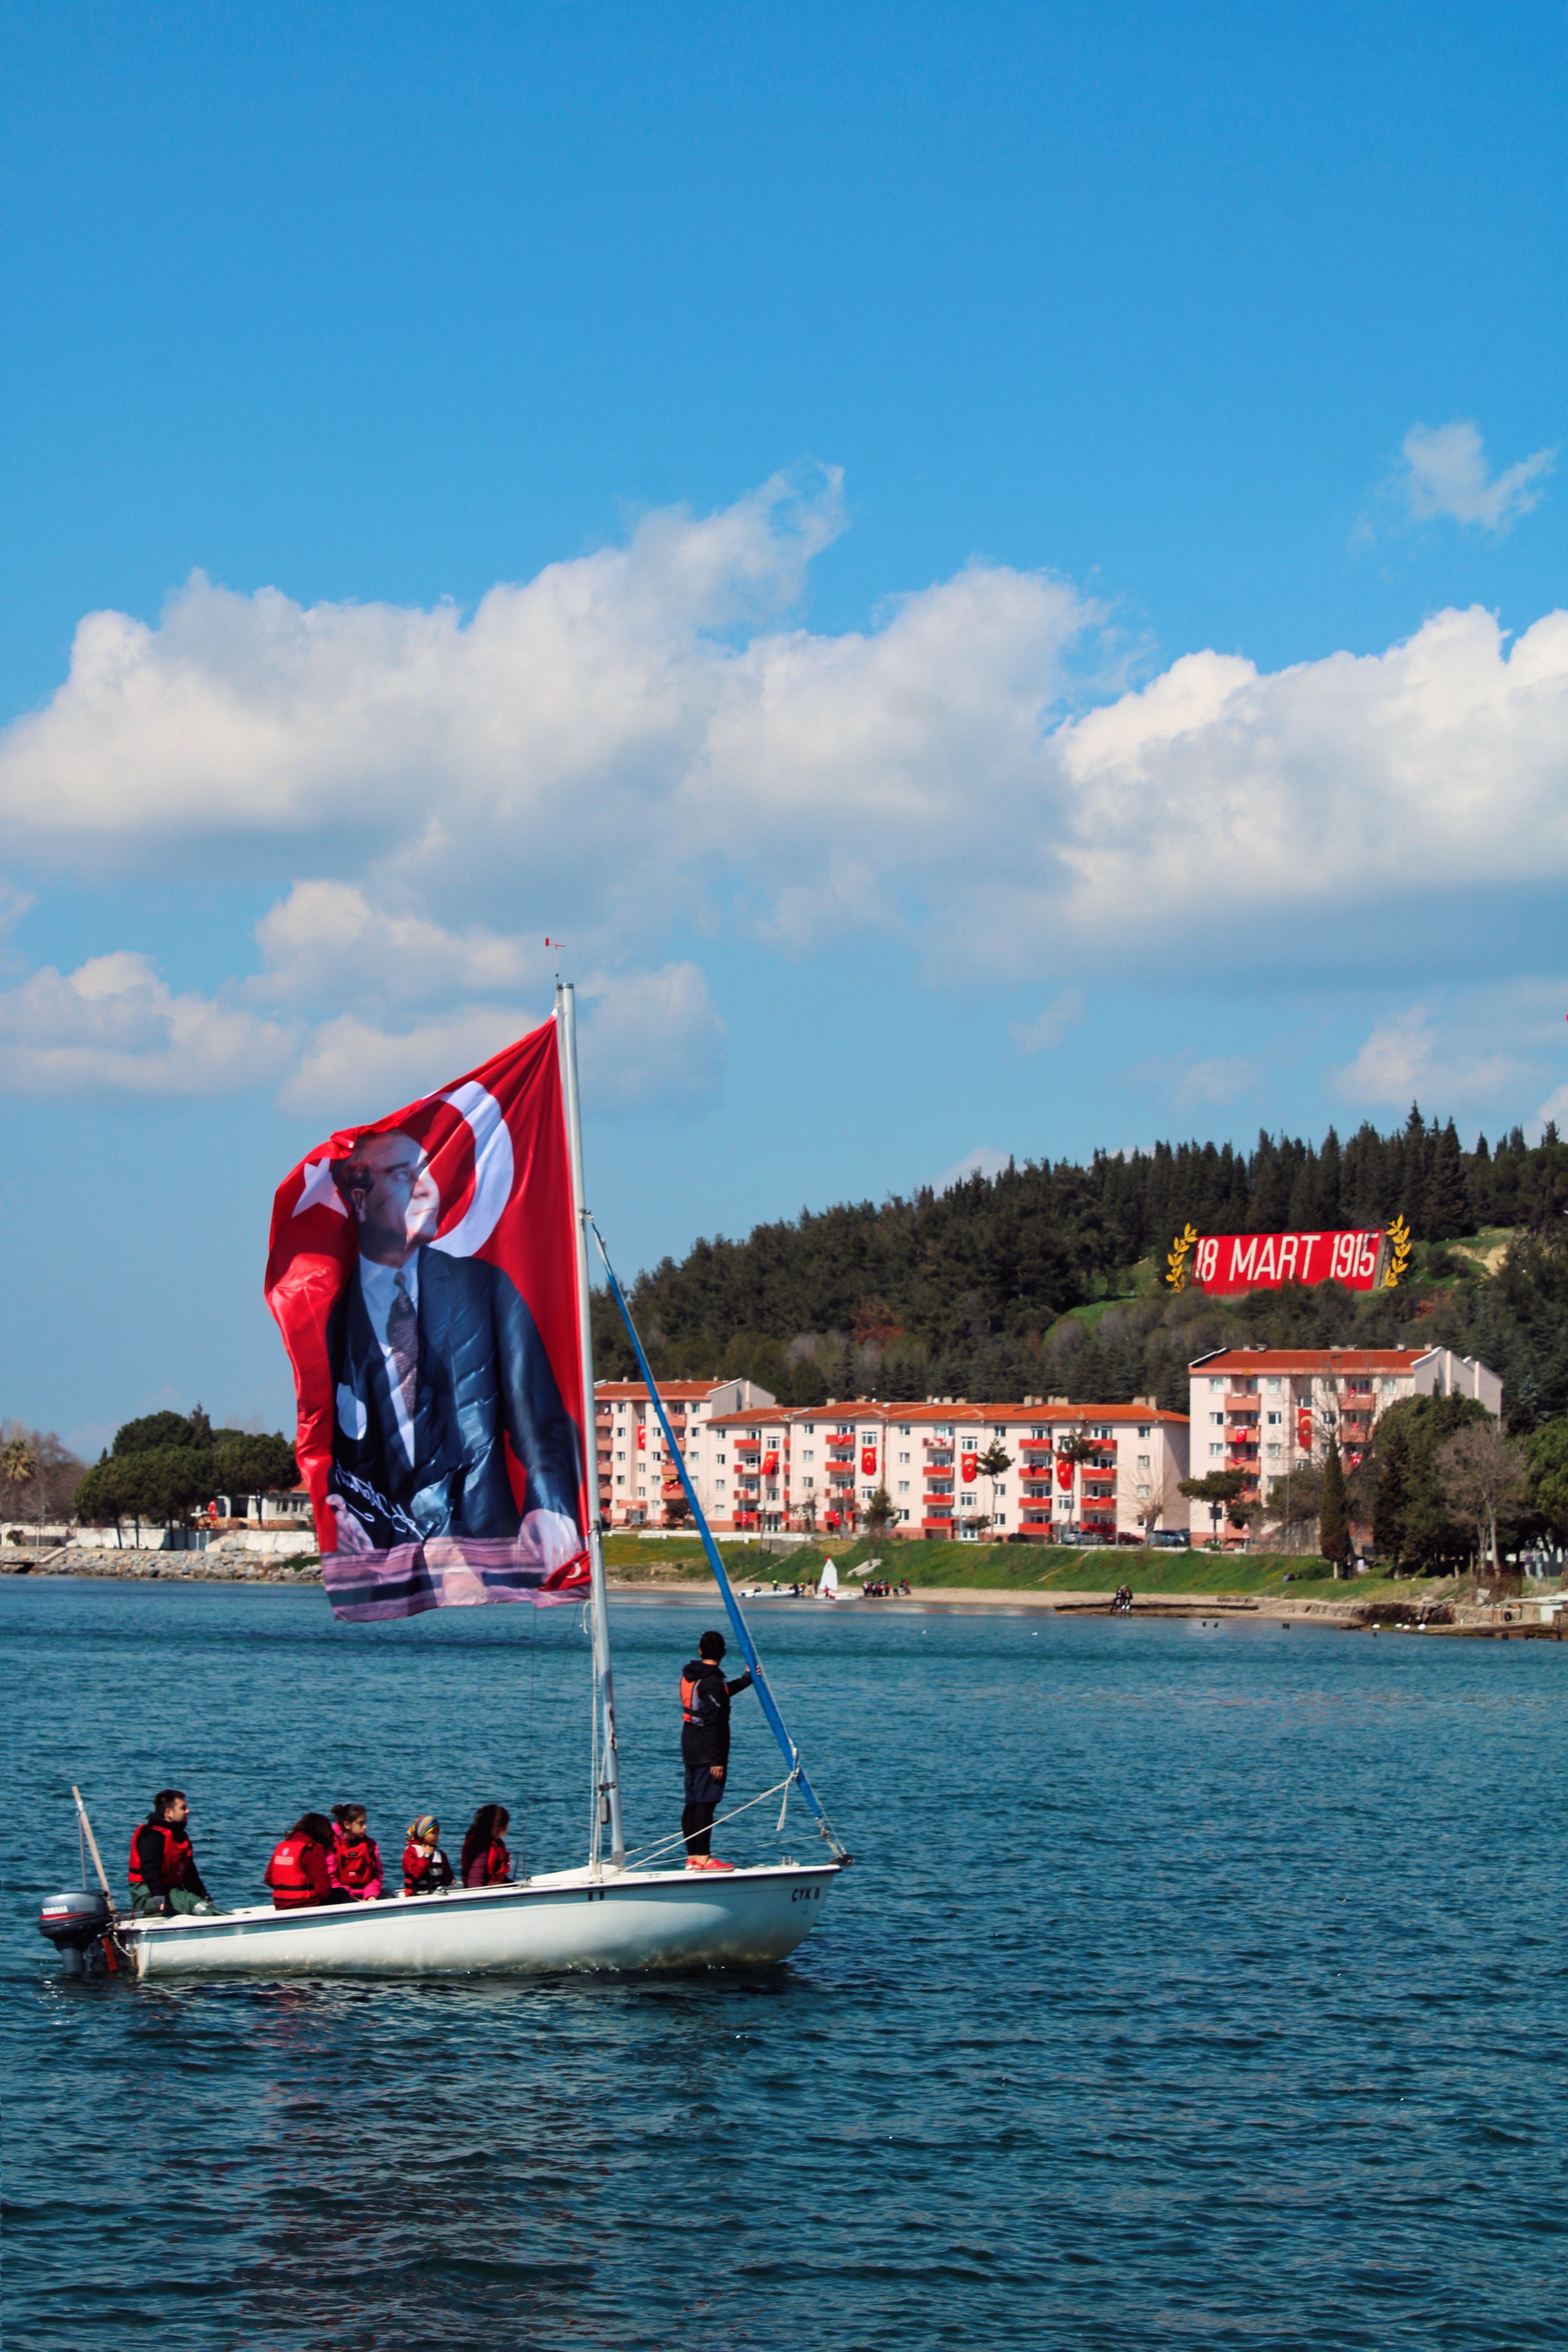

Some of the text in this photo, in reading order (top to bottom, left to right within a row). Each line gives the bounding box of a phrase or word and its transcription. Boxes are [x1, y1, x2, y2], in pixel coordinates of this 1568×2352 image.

[1195, 1233, 1379, 1282] 18 MART 1915
